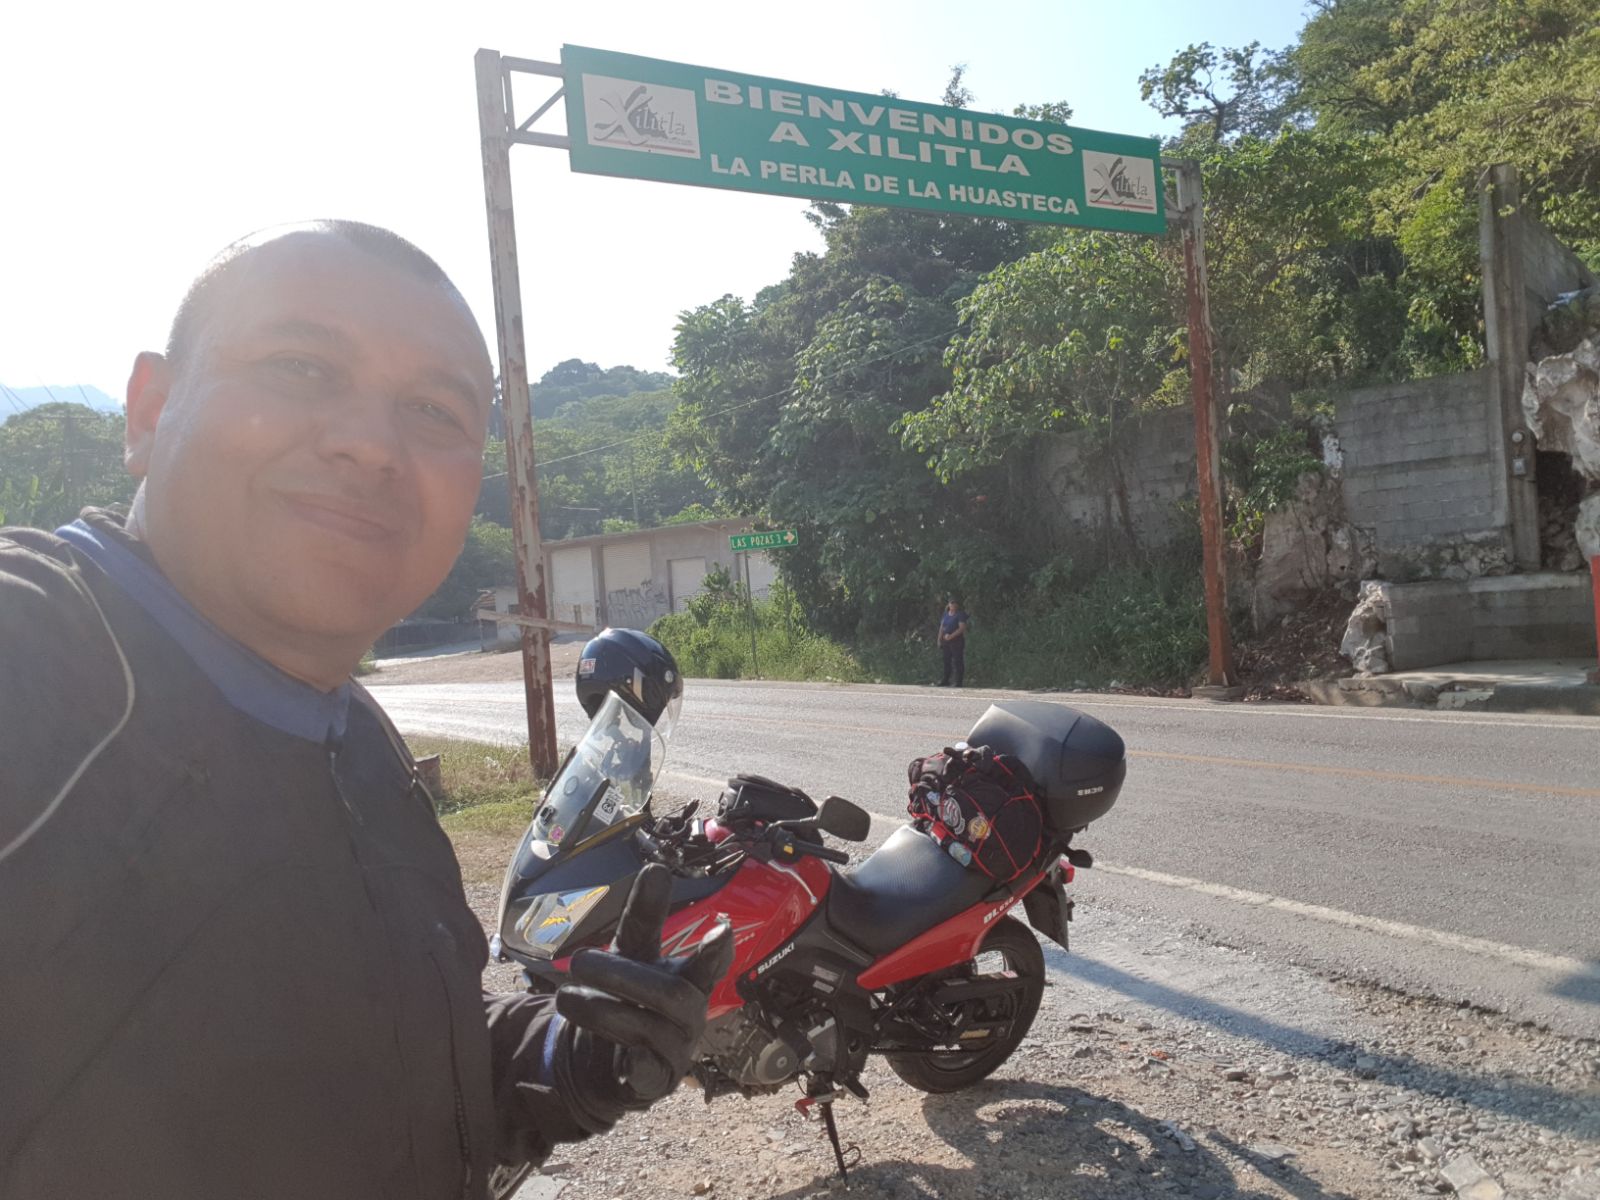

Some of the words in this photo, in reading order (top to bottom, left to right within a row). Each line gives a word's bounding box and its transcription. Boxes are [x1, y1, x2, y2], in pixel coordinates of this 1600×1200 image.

[593, 85, 688, 146] Xilitla
[703, 77, 1074, 156] BIENVENIDOS
[769, 121, 810, 147] A
[828, 128, 1031, 176] XILITLA
[710, 153, 753, 177] LA
[759, 159, 856, 191] PERLA
[863, 173, 900, 195] DE
[908, 179, 942, 199] LA
[949, 183, 1080, 217] HUASTECA
[731, 537, 747, 549] LAS
[750, 534, 775, 546] POZAS
[757, 941, 795, 975] SUZUKI
